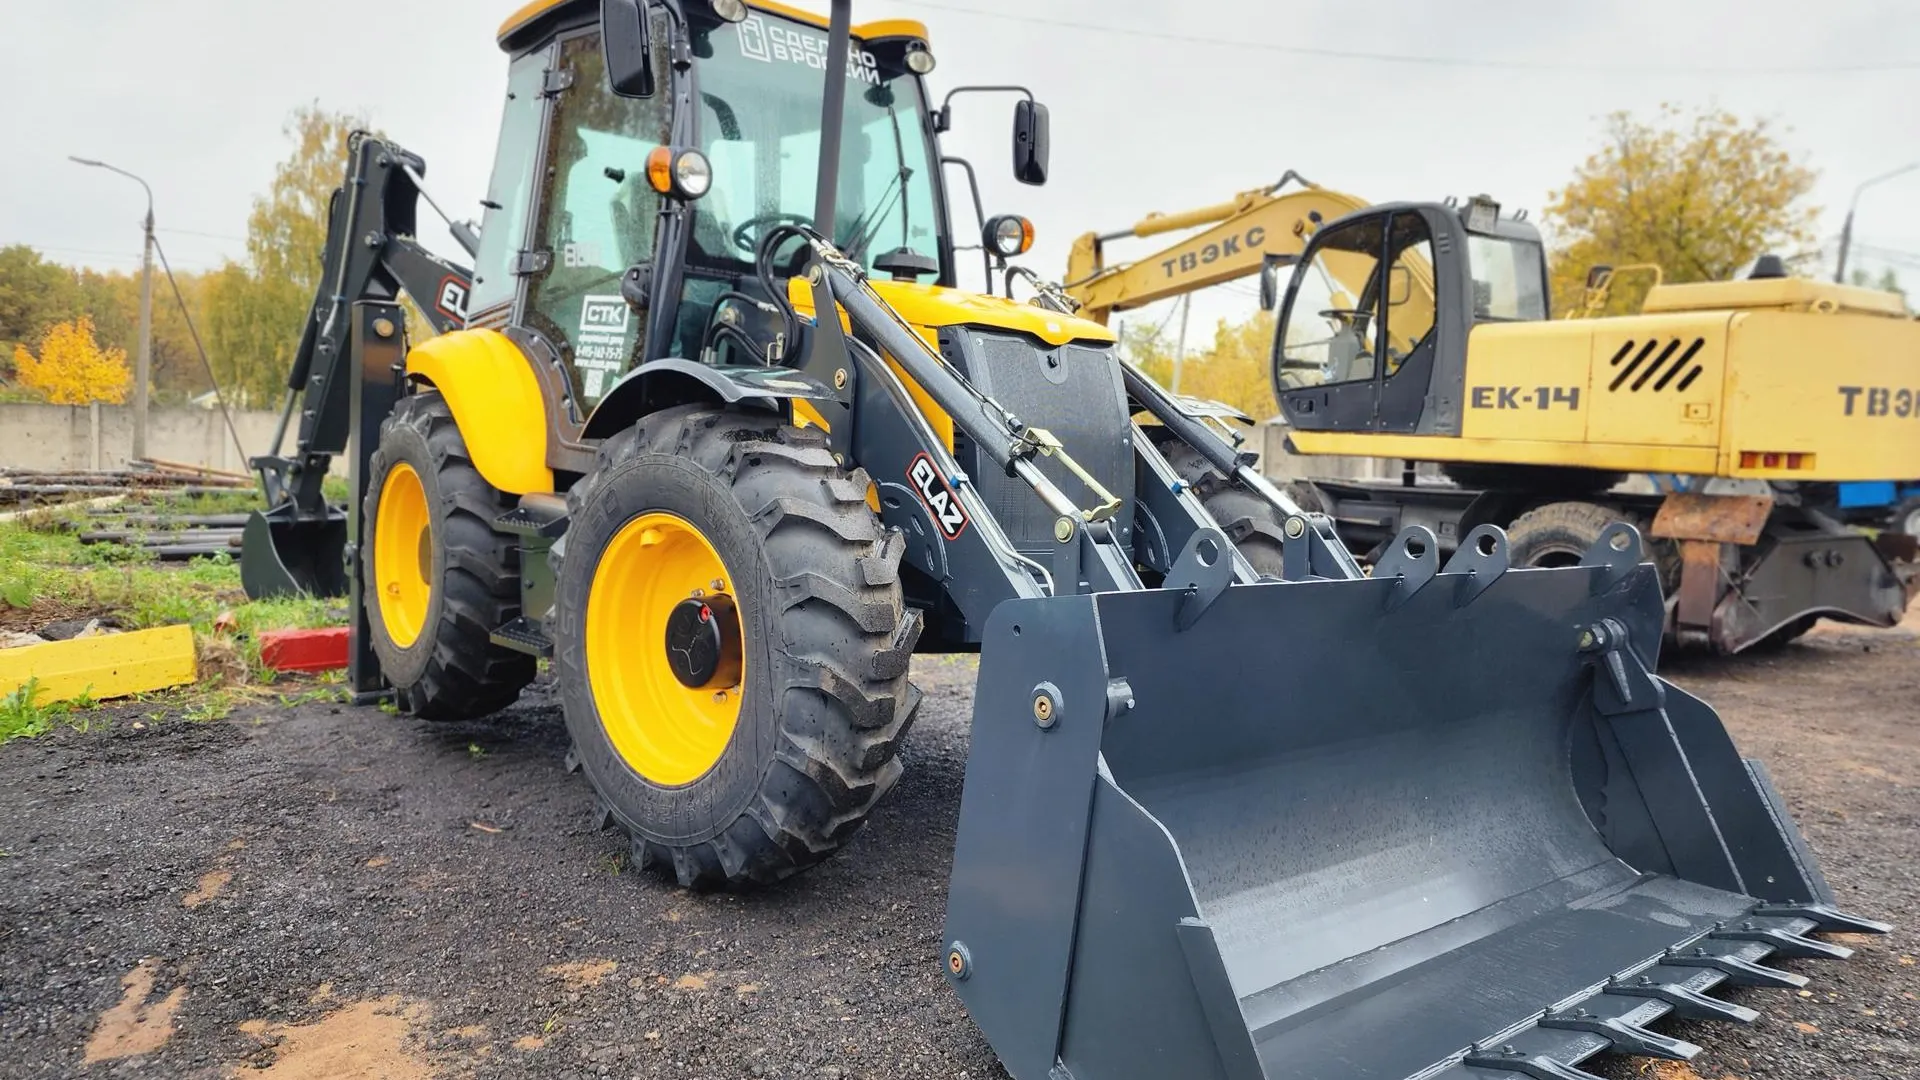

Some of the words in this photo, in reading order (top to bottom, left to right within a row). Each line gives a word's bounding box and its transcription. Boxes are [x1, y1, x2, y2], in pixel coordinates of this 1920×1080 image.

[1161, 226, 1265, 278] ТВЭКС
[440, 282, 467, 320] EL
[911, 458, 964, 534] ELAZ
